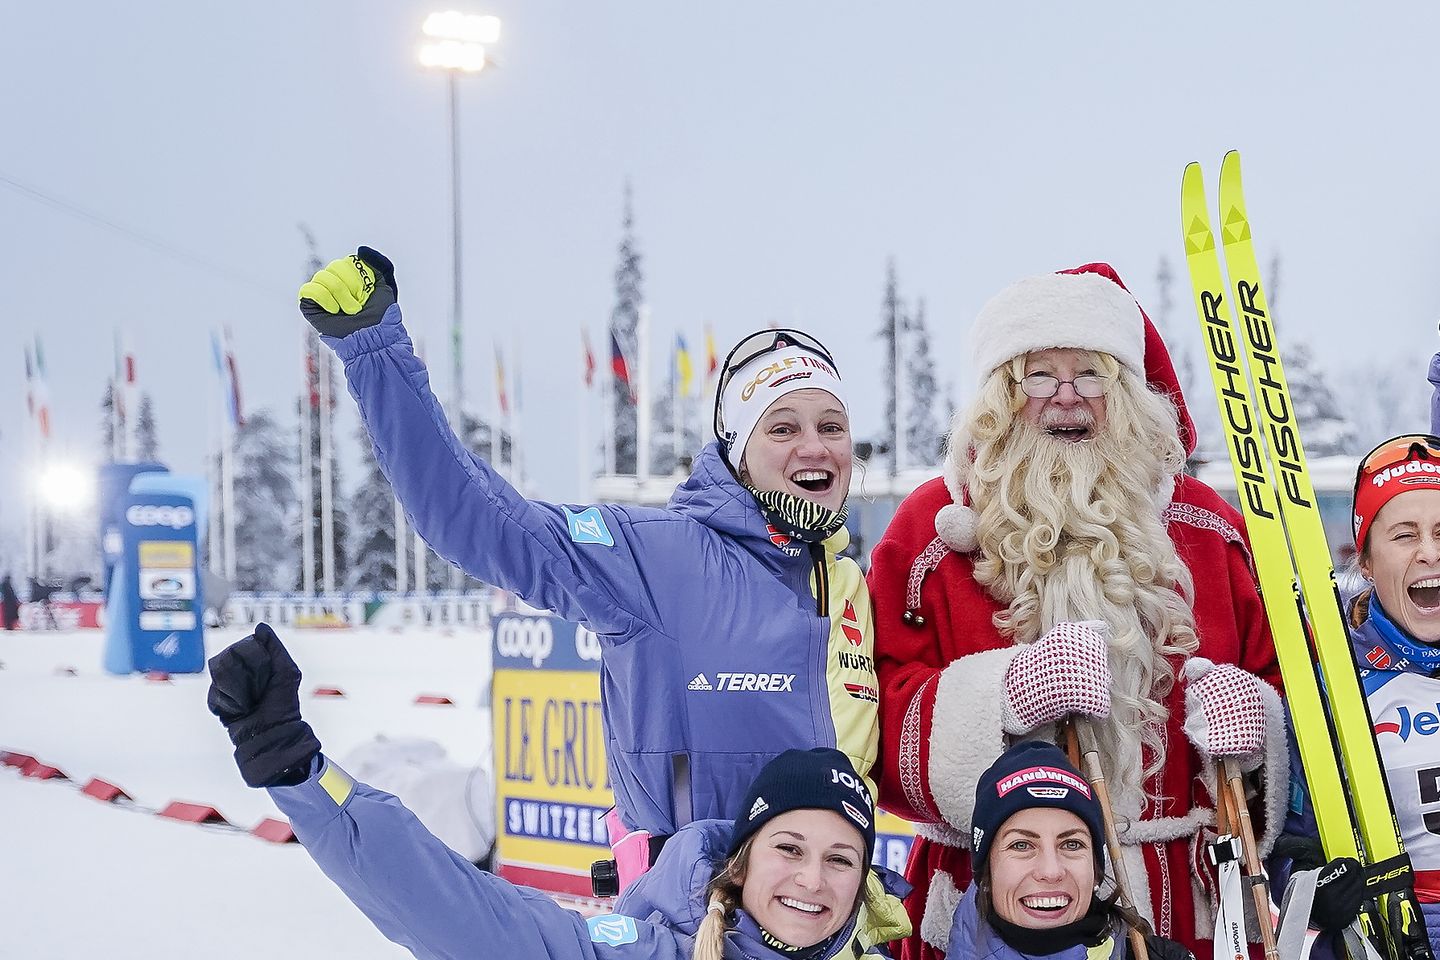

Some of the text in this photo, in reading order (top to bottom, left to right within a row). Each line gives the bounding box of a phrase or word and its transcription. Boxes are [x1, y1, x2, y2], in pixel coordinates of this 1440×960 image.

[1200, 290, 1274, 520] FISCHER
[1237, 280, 1311, 508] FISCHER
[716, 672, 797, 692] TERREX
[504, 697, 535, 783] LE
[1000, 767, 1089, 796] HANDWERK
[1366, 864, 1410, 886] CHER
